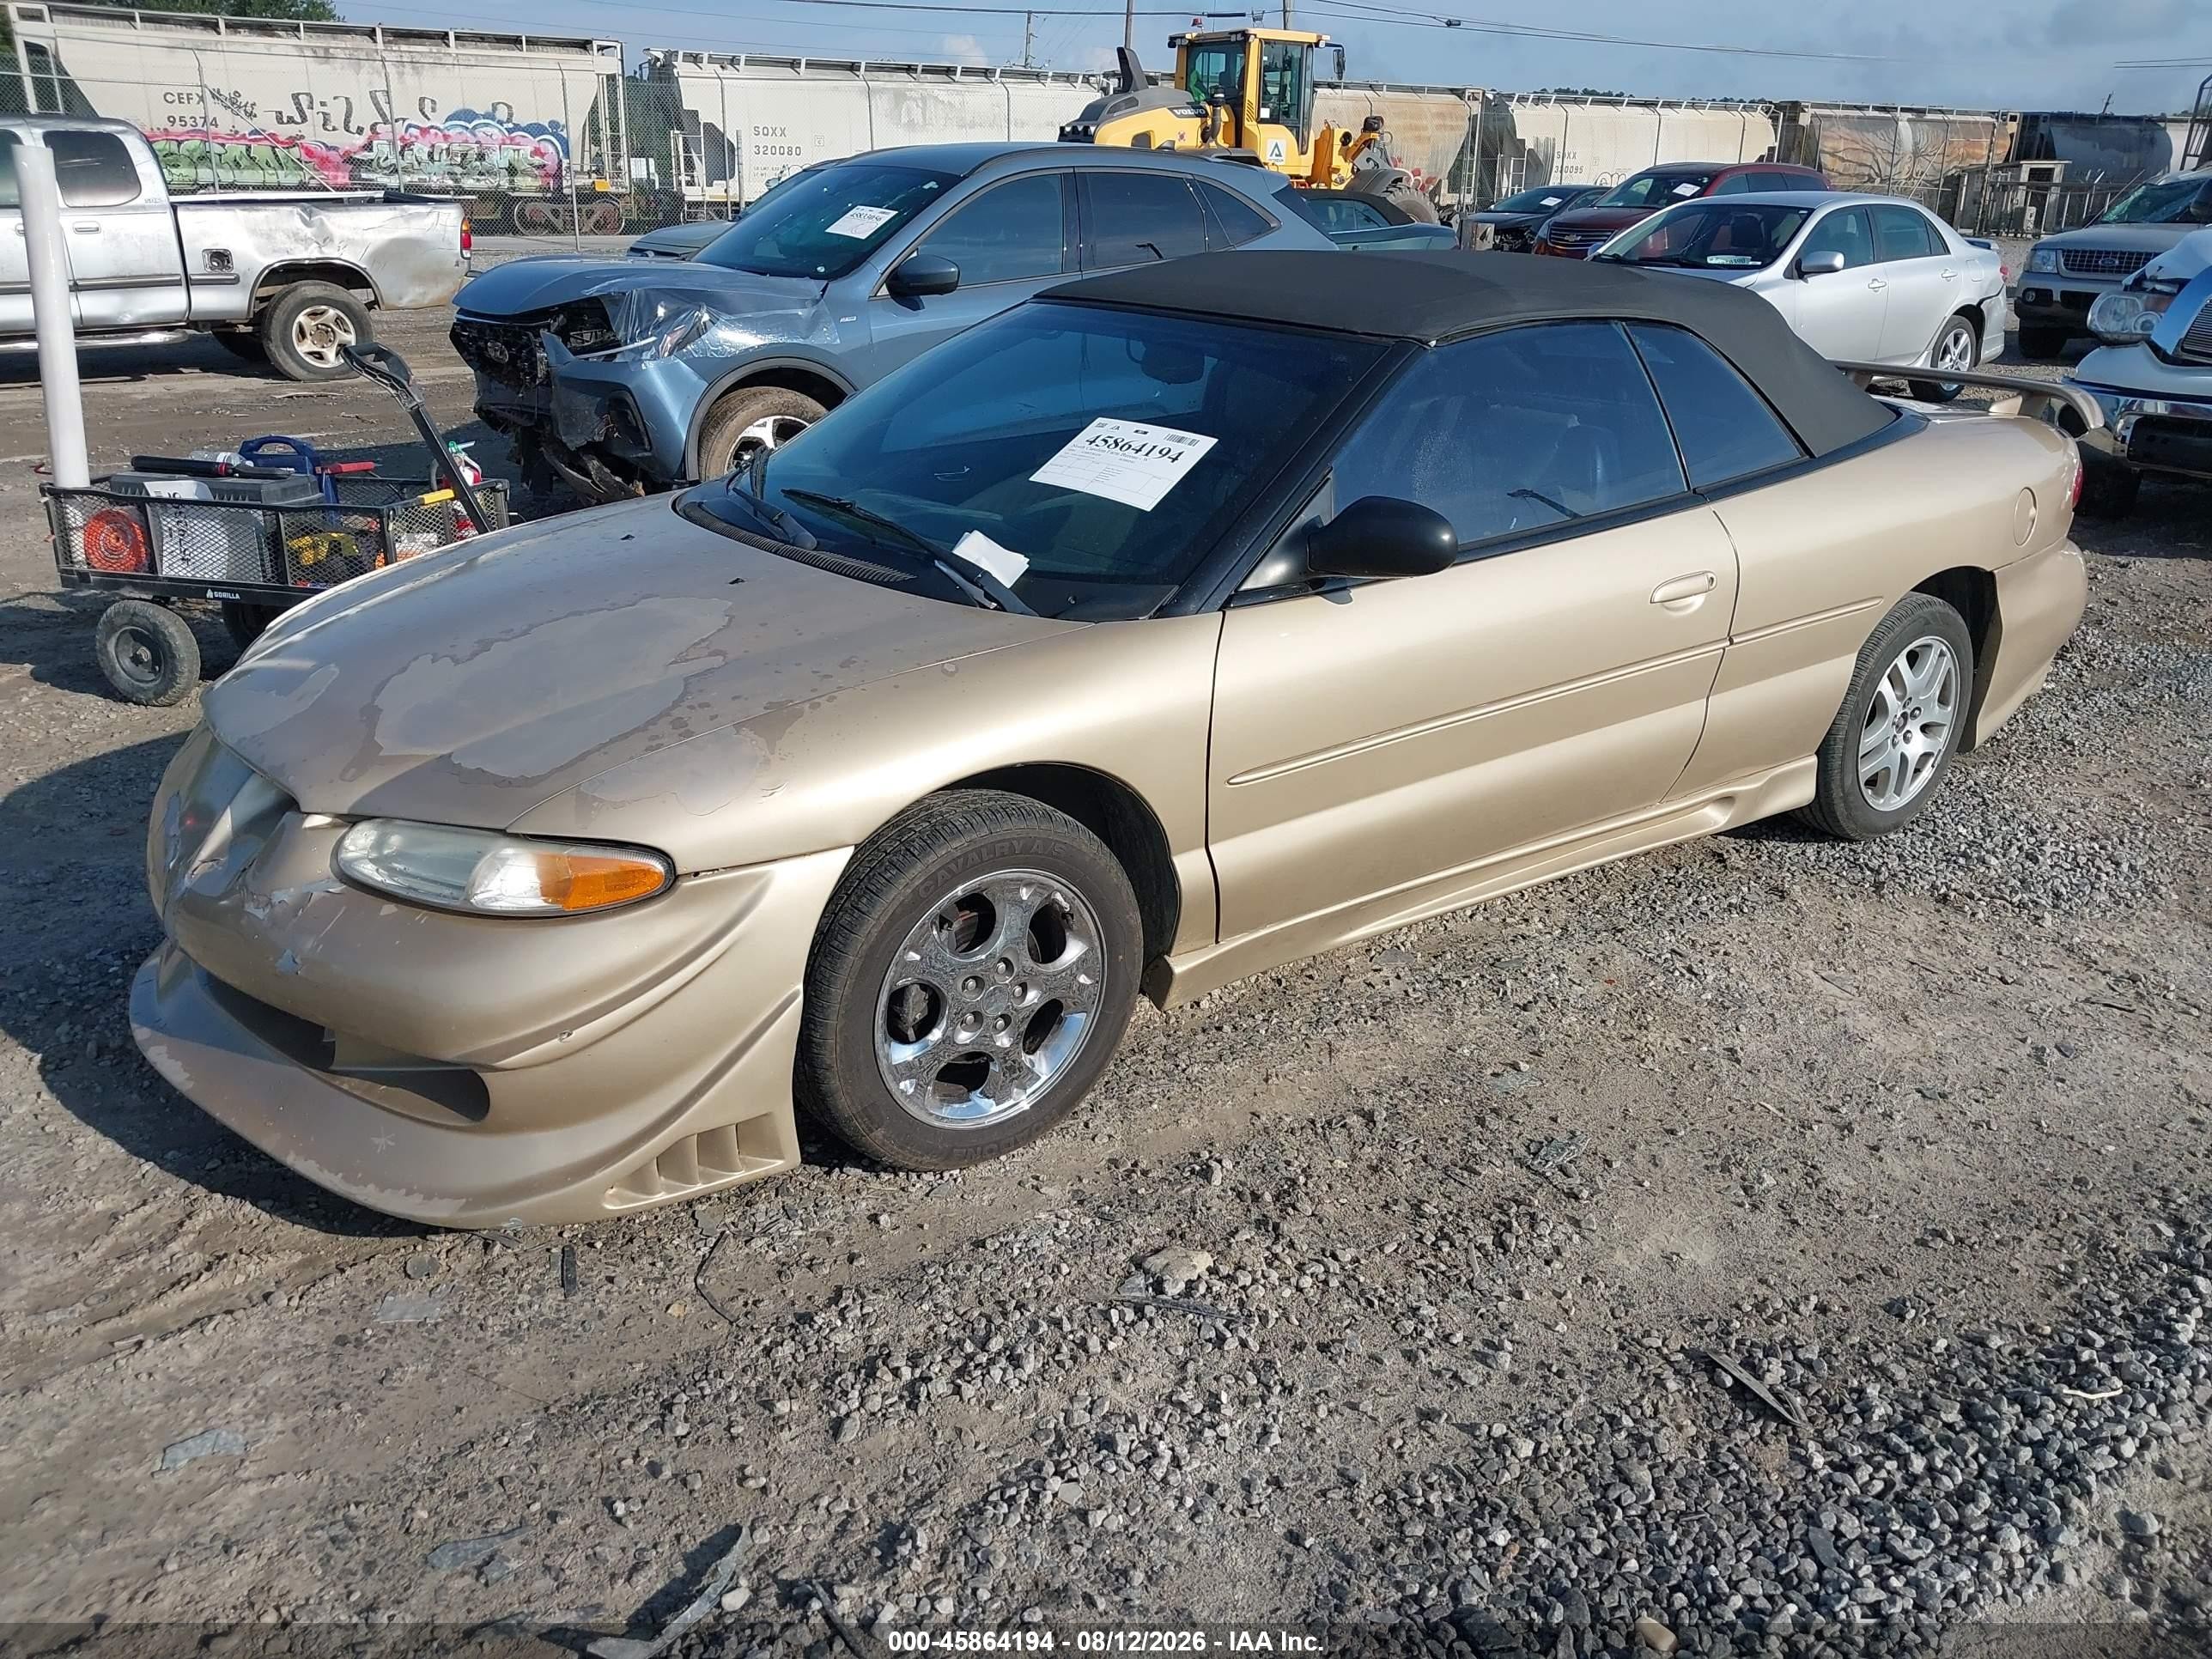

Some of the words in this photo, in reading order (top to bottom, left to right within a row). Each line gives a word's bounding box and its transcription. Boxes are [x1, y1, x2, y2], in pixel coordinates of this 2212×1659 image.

[167, 115, 219, 129] 95374
[754, 144, 802, 156] 320080
[1085, 434, 1185, 464] 45864194
[214, 591, 240, 599] GORILLA
[919, 839, 1024, 899] CAVALRY
[1030, 840, 1066, 857] A/S
